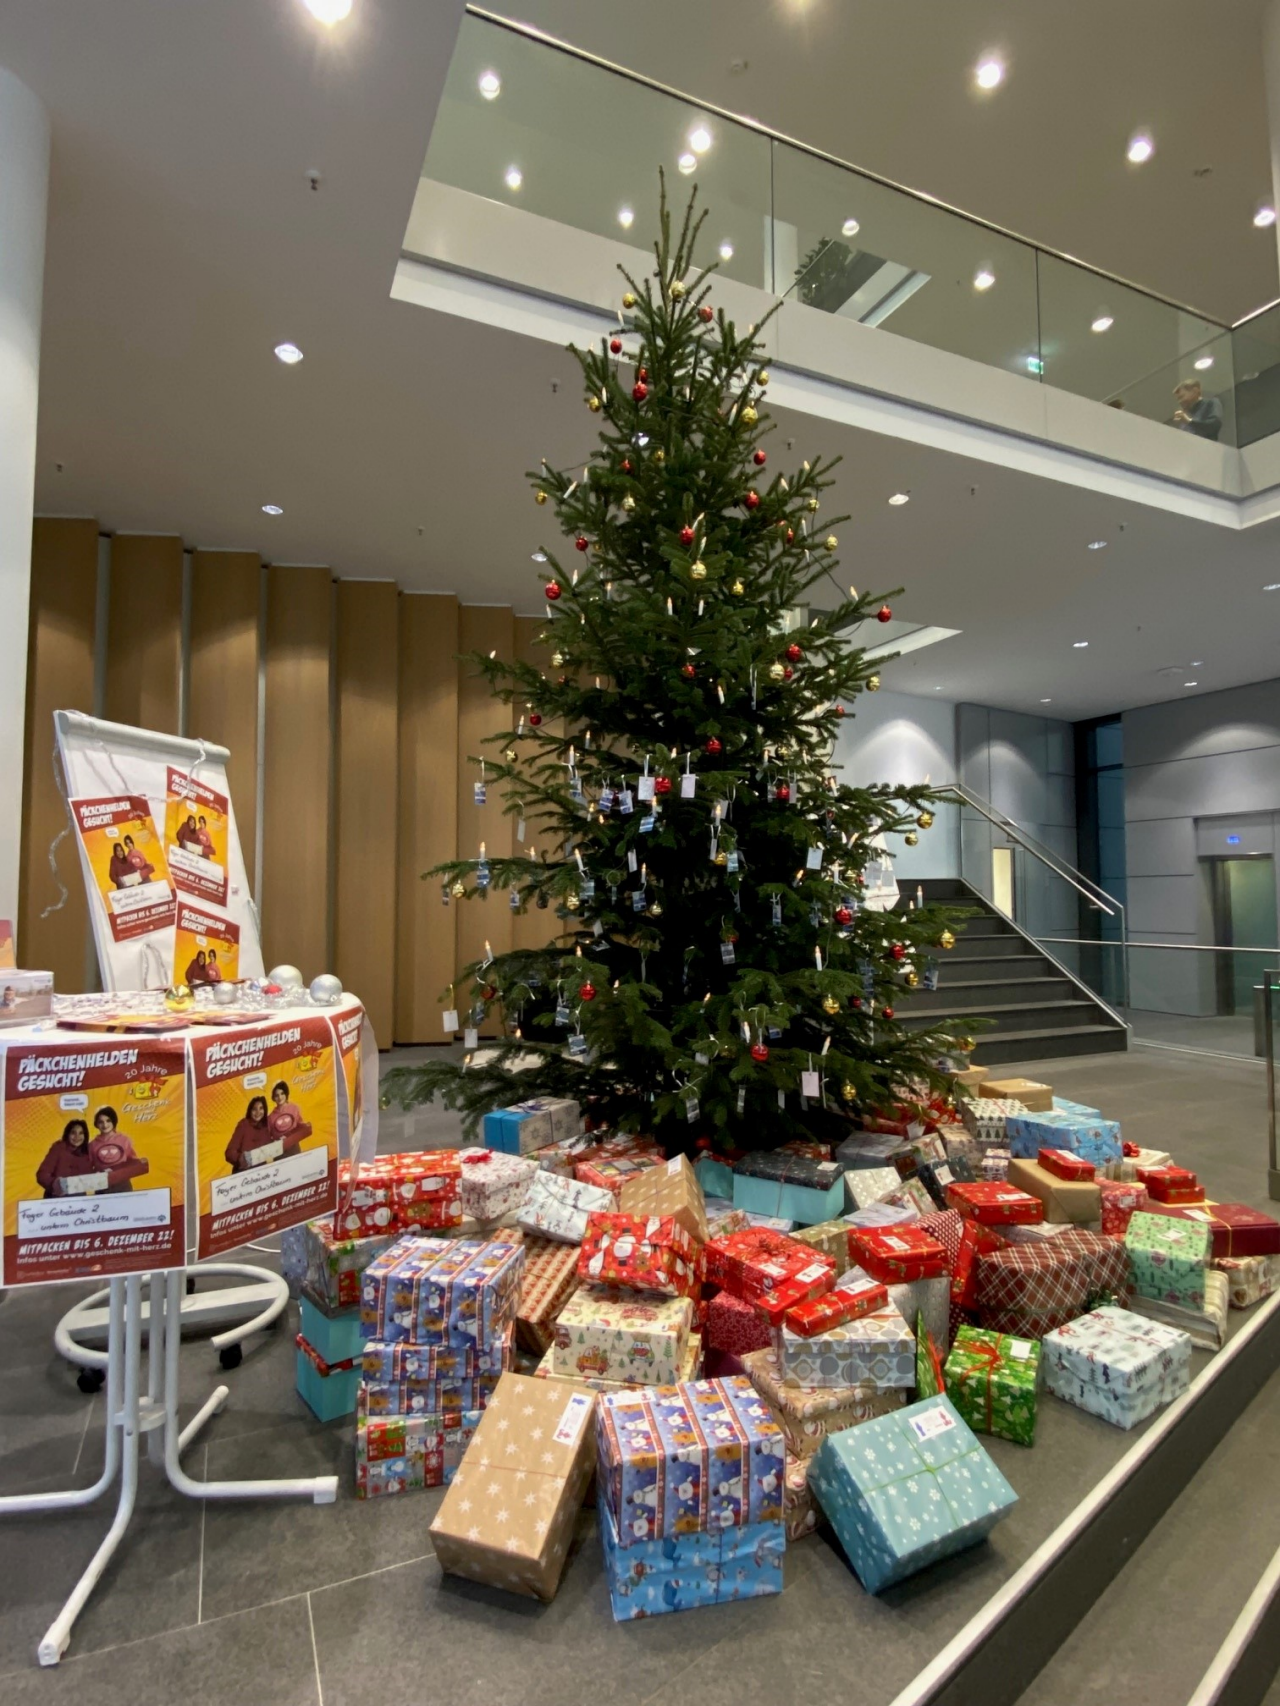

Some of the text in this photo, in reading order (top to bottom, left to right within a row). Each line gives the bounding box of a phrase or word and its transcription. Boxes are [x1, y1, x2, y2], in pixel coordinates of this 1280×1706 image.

[206, 1027, 300, 1062] PÄCKCHENHELDEN
[303, 1040, 322, 1049] Jahre
[18, 1049, 138, 1074] PÄCKCHENHELDEN
[124, 1064, 168, 1080] 20 Jahre
[206, 1051, 264, 1078] GESUCHT!
[18, 1071, 86, 1092] GESUCHT!
[272, 1168, 280, 1179] 2
[50, 1206, 86, 1217] Gebäude
[92, 1204, 100, 1213] 2
[212, 1208, 254, 1231] MITPACKEN
[256, 1204, 270, 1217] BIS
[272, 1200, 279, 1210] 6.
[282, 1186, 316, 1206] DEZEMBER
[318, 1180, 330, 1193] 22!
[74, 1215, 129, 1227] Christbaum
[210, 1230, 227, 1240] Infos
[228, 1223, 246, 1232] unter
[17, 1242, 172, 1264] Infos unter www.geschenk-mit-herz.de
[19, 1230, 175, 1255] MITPACKEN BIS 6. DEZEMBER 22!
